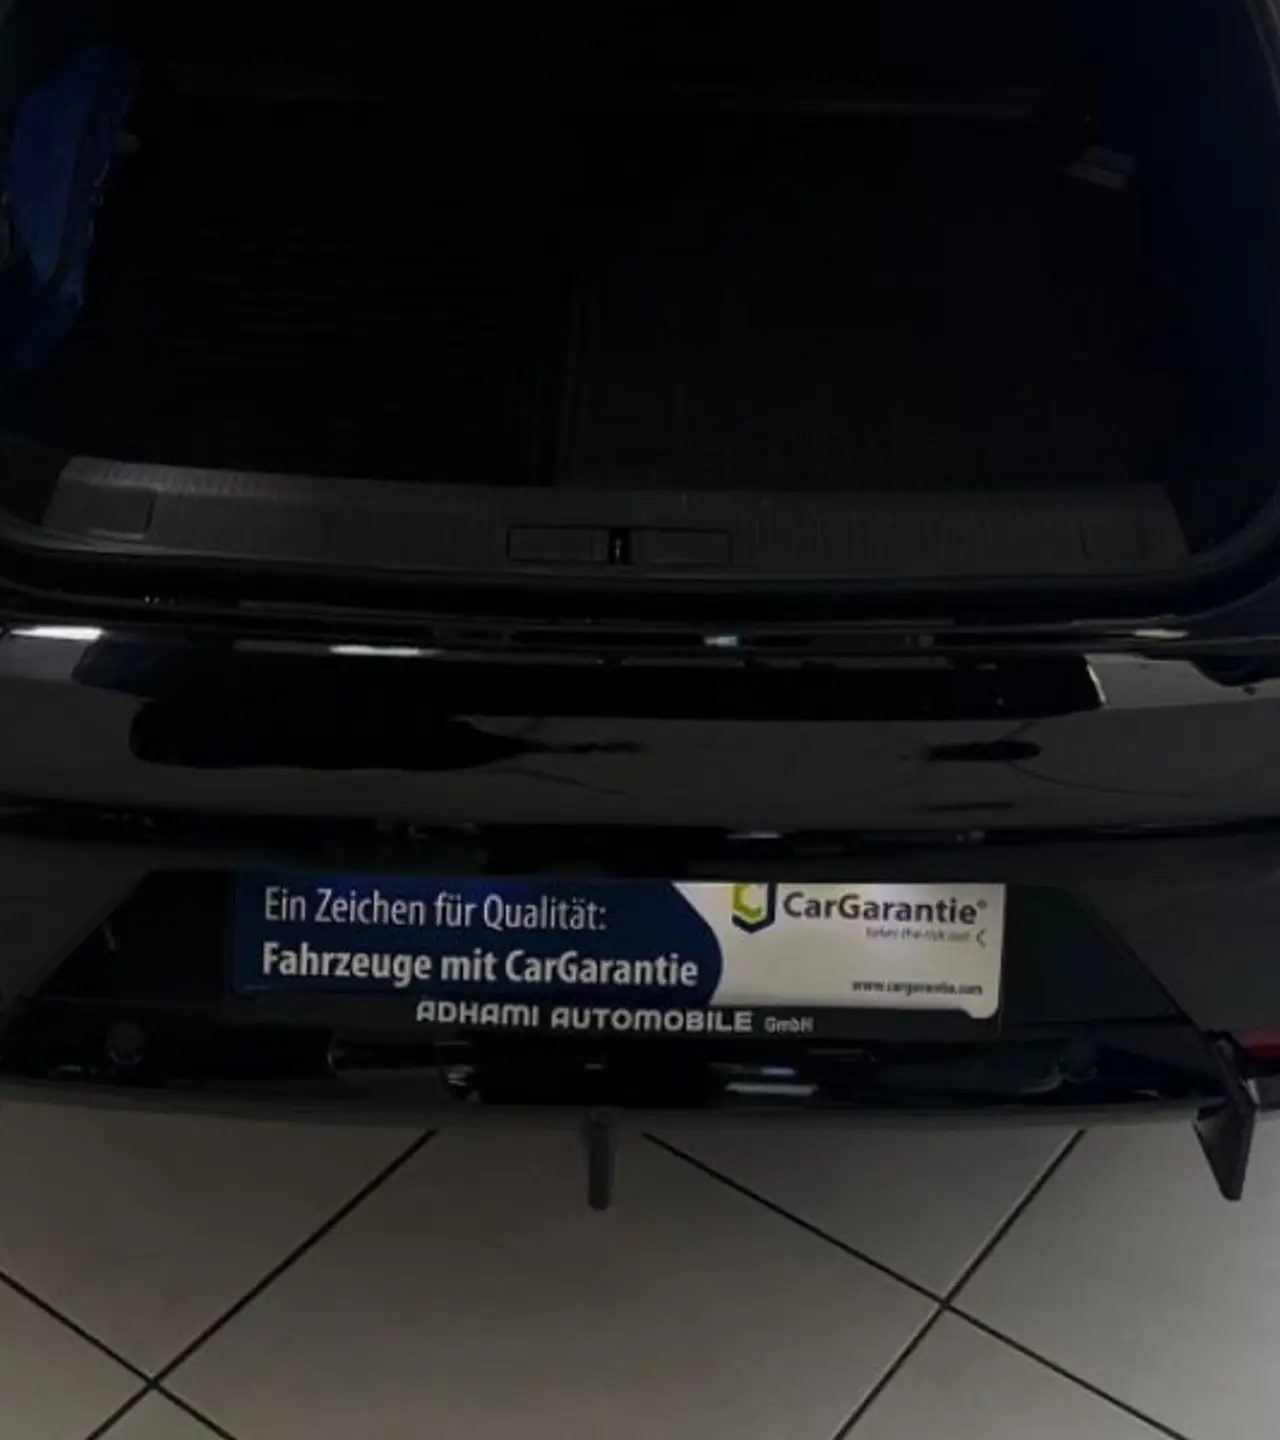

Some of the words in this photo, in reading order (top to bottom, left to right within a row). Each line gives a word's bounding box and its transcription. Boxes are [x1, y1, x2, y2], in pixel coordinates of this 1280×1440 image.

[264, 886, 306, 922] Ein
[314, 888, 425, 926] Zeichen
[434, 890, 478, 928] für
[483, 893, 607, 931] Qualität:
[262, 941, 432, 988] Fahrzeuge
[441, 948, 497, 982] mit
[505, 950, 699, 987] CarGarantie
[416, 1000, 539, 1027] ADHAMI
[551, 1006, 753, 1033] AUTOMOBILE
